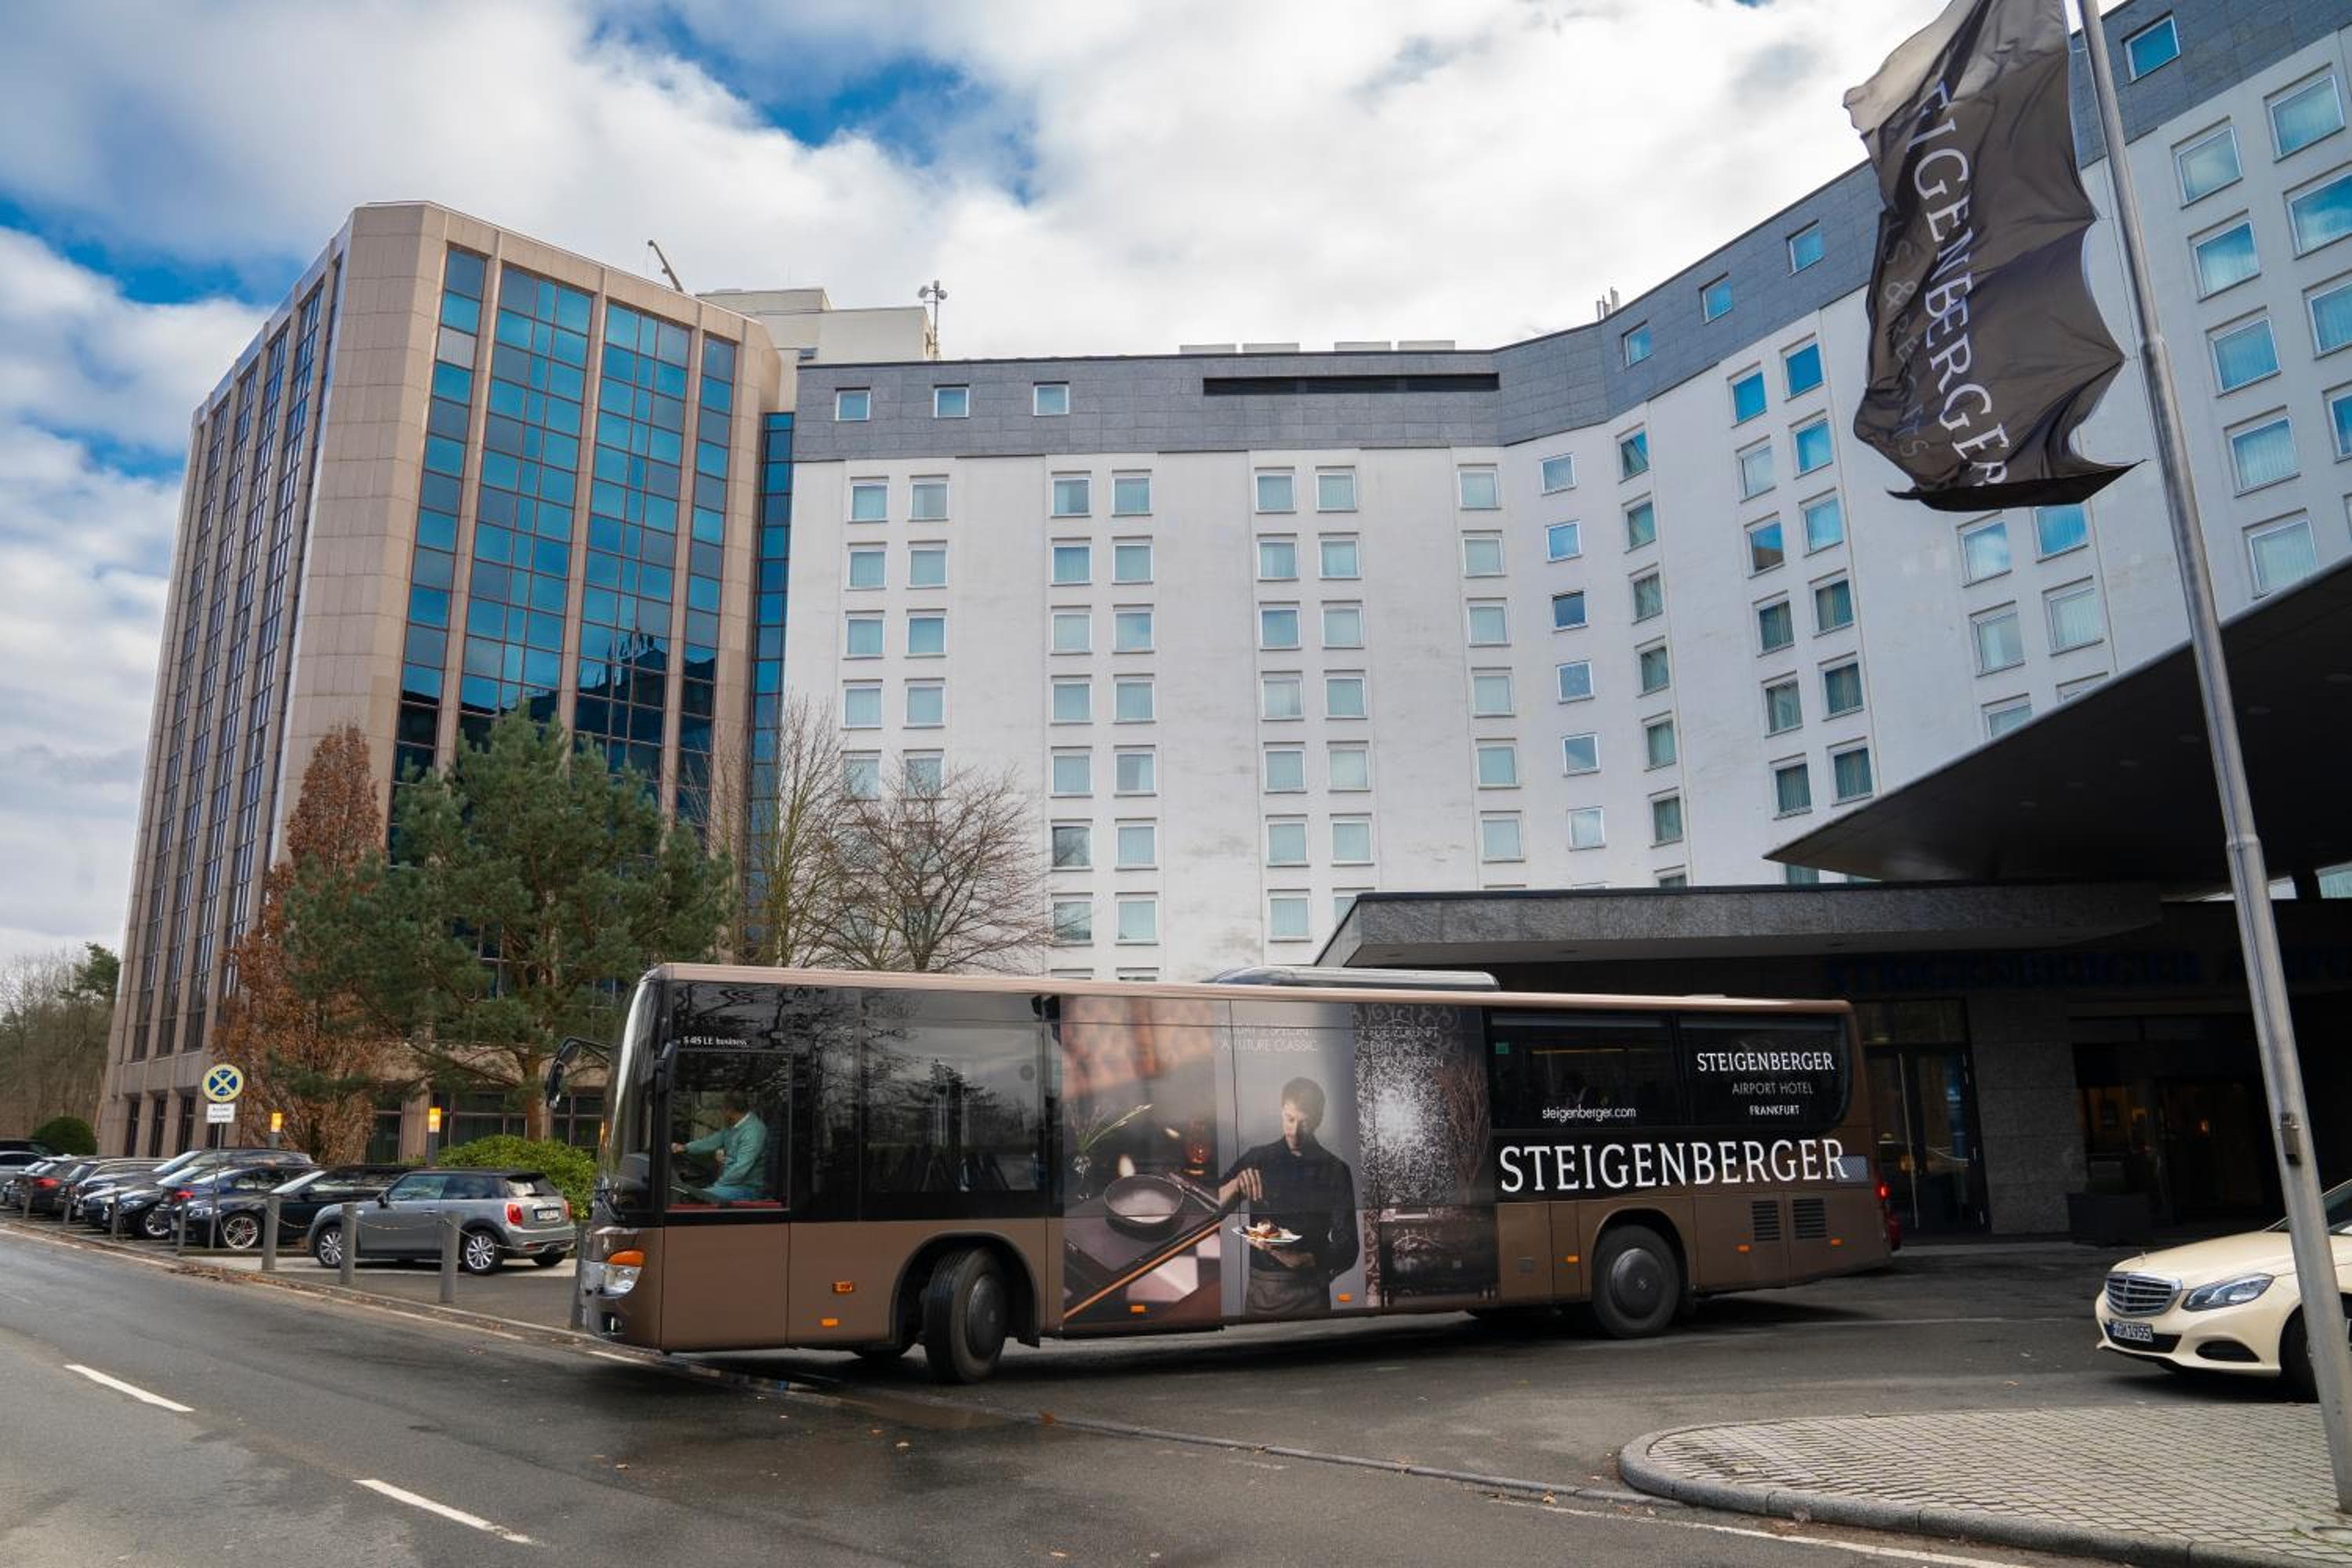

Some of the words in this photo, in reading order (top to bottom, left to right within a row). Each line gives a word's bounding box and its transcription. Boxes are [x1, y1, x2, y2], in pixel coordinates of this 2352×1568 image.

[1697, 1051, 1835, 1072] STEIGENBERGER
[1732, 1082, 1777, 1095] AIRPORT
[1779, 1082, 1813, 1094] HOTEL
[1542, 1105, 1637, 1123] steigenberger.com
[1749, 1105, 1800, 1116] FRANKFURT
[1499, 1138, 1849, 1192] STEIGENBERGER
